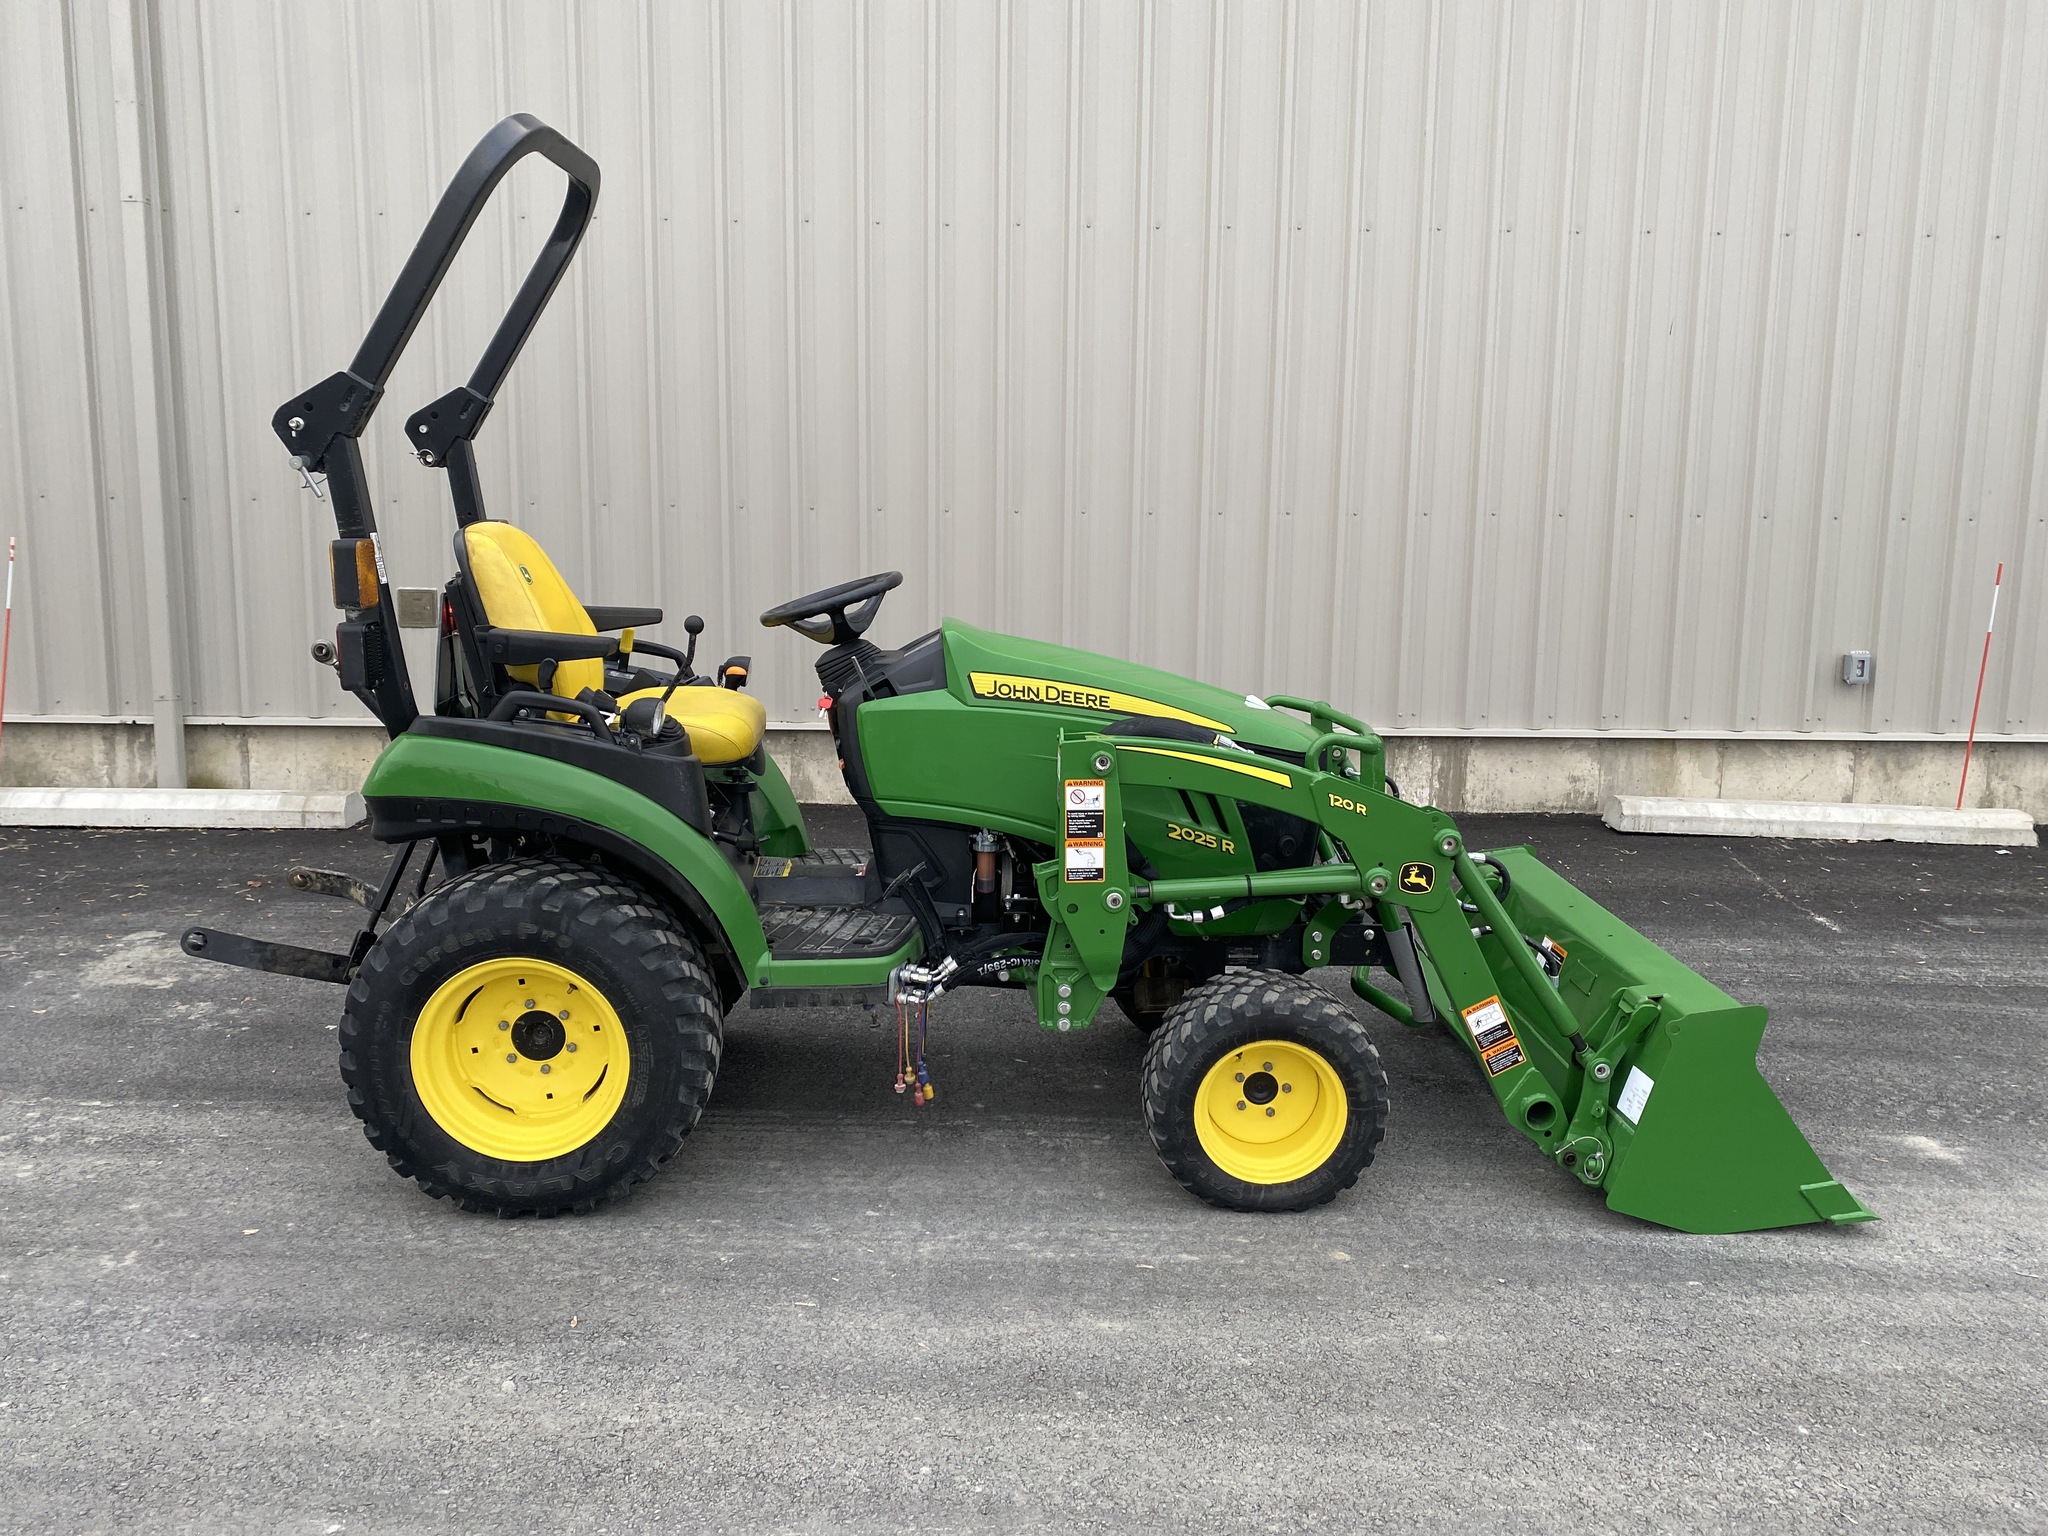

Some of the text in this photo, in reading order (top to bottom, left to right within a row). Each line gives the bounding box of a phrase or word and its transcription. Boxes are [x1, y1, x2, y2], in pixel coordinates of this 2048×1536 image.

[986, 680, 1111, 709] JOHN DEERE
[1328, 793, 1368, 816] 120 R
[1166, 823, 1235, 855] 2025 R
[1472, 999, 1495, 1012] WARNING
[1492, 1041, 1515, 1054] WARNING
